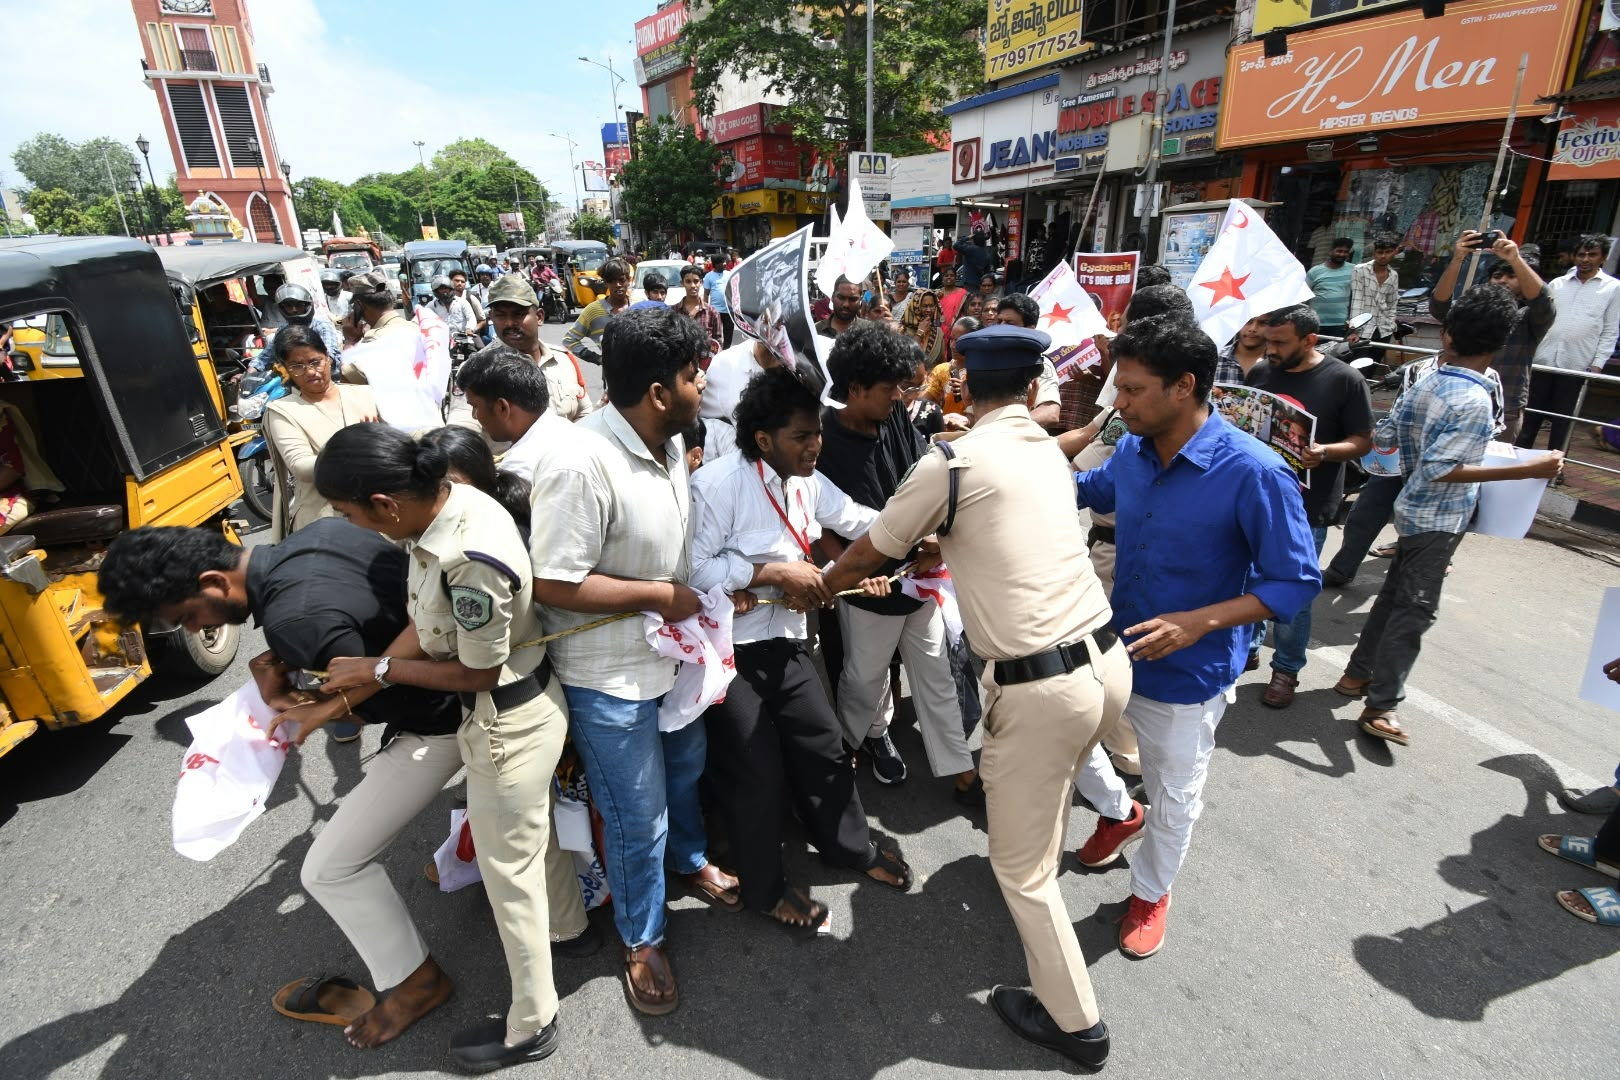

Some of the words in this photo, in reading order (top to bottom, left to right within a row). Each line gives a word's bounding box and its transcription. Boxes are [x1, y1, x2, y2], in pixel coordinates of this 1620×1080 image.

[1336, 35, 1498, 110] Men
[1062, 98, 1077, 109] Sree
[1077, 87, 1116, 104] Kameswari
[741, 114, 759, 126] GOLD
[1057, 95, 1135, 135] MOBILE
[1319, 113, 1367, 131] HIPSTER
[1369, 106, 1419, 125] TRENDS
[1055, 130, 1109, 154] MOBILES
[1572, 144, 1613, 164] Offer
[900, 208, 933, 220] POLICE
[1080, 261, 1132, 274] Gyanesh
[1079, 274, 1094, 285] IT'S
[1094, 275, 1114, 286] DONE
[1115, 273, 1131, 285] BRO
[1075, 346, 1099, 366] DYFI
